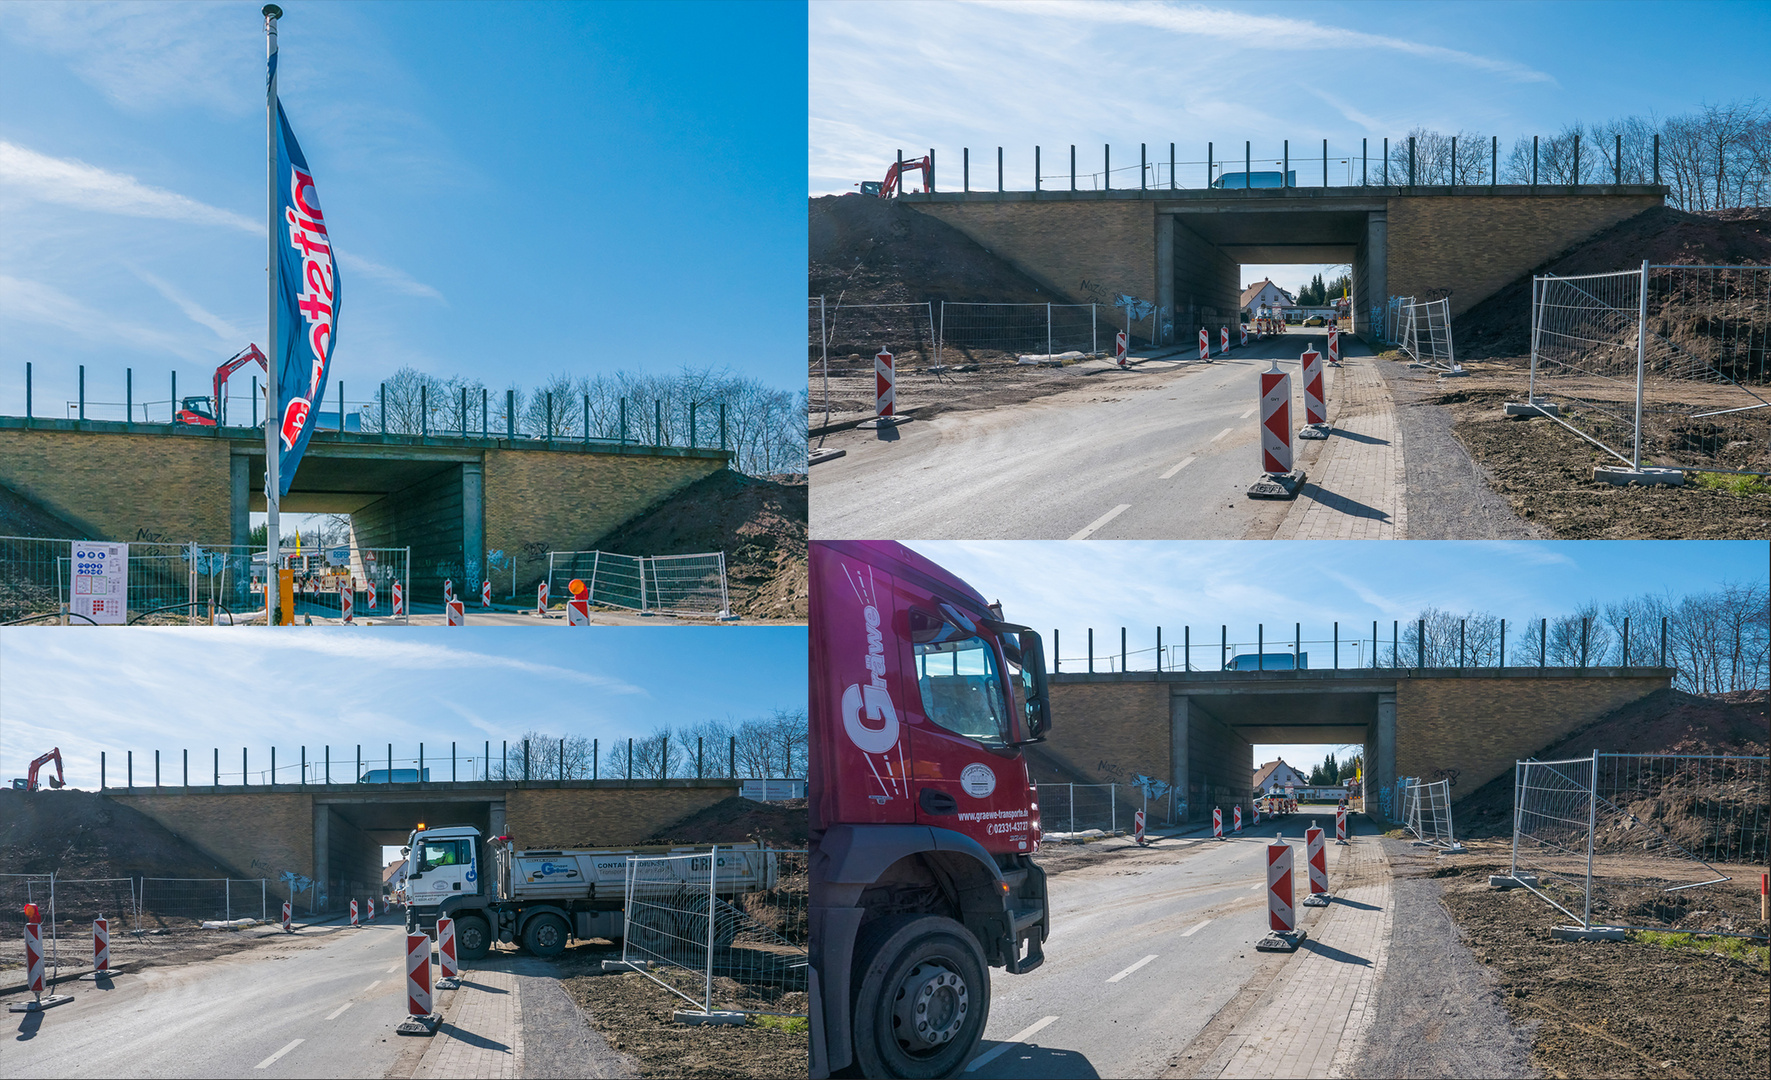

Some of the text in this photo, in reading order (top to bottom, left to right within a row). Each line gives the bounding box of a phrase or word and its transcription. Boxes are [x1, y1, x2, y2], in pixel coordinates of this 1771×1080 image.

[136, 528, 173, 548] Nazis
[842, 605, 900, 754] Gräwe
[957, 807, 1029, 823] www.graewe-transporte.de
[994, 821, 1028, 834] 02331-43727
